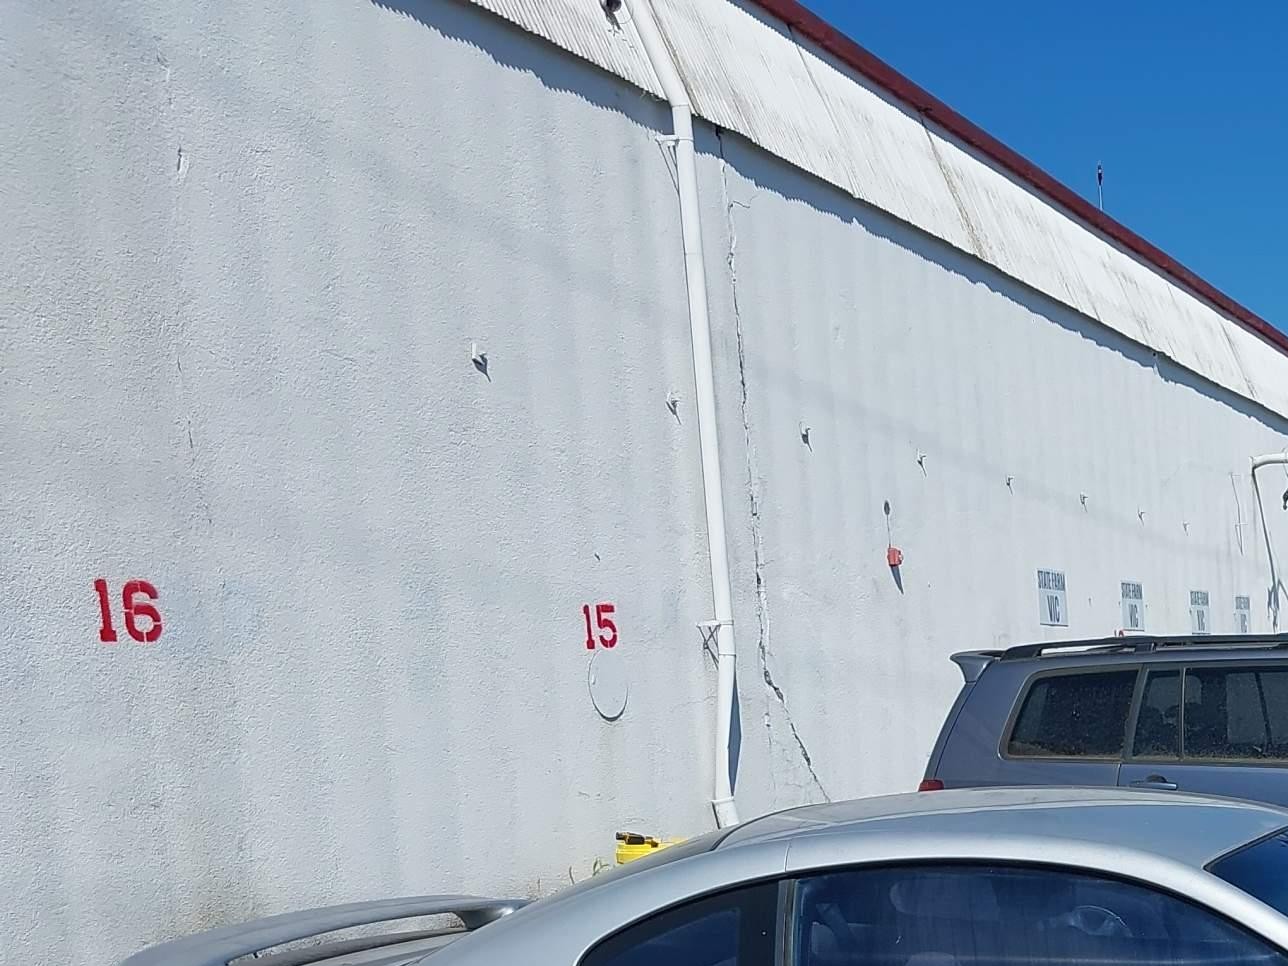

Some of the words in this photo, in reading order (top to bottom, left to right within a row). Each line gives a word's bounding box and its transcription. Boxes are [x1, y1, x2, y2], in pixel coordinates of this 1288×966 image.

[1037, 570, 1051, 590] STATE
[1051, 571, 1066, 592] FARM
[1121, 582, 1132, 599] STATE
[94, 579, 162, 643] 16
[1046, 595, 1060, 623] VIC
[1128, 603, 1139, 628] VIC
[582, 603, 618, 650] 15
